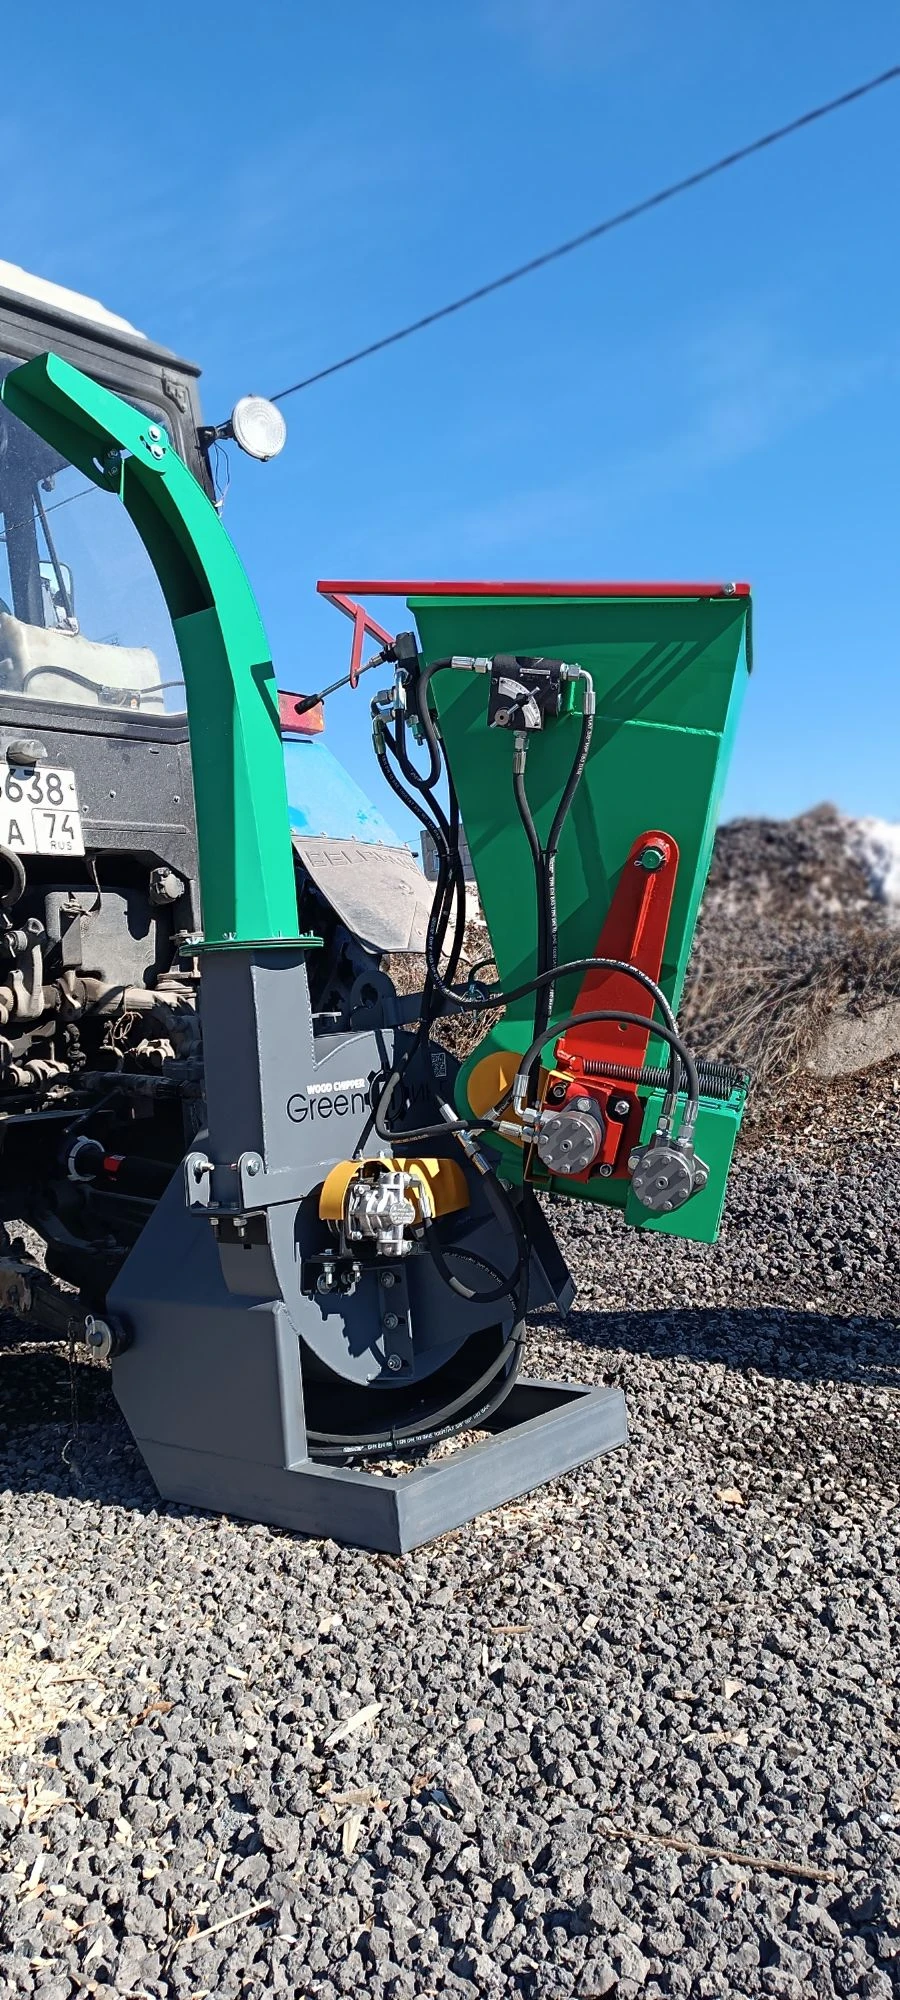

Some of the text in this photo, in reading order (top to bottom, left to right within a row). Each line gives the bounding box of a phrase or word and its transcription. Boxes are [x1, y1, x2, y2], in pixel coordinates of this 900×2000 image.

[0, 770, 63, 806] 638
[8, 813, 74, 845] A 74
[50, 840, 72, 851] RUS
[306, 1078, 366, 1095] WOOD CHIPPER
